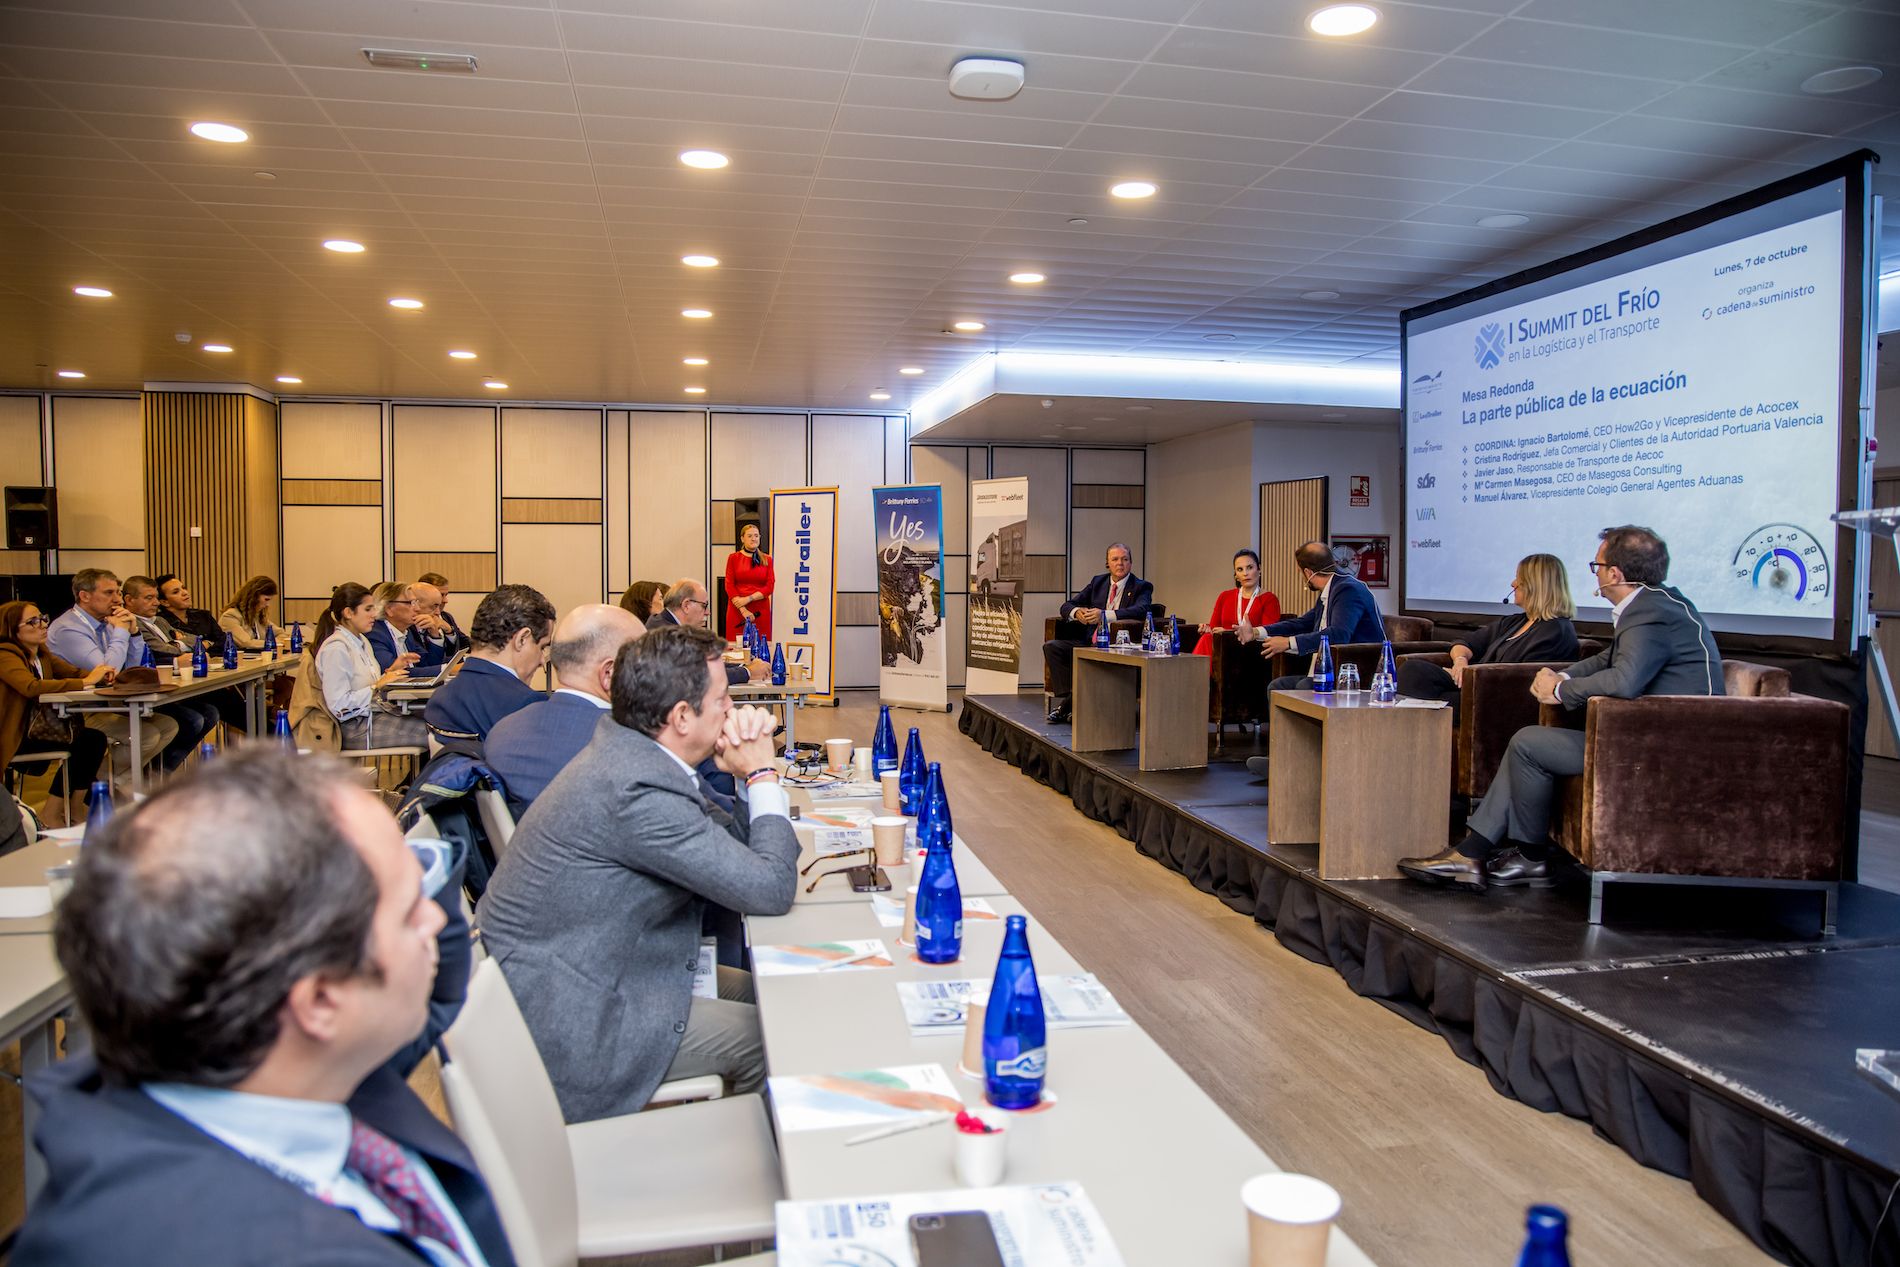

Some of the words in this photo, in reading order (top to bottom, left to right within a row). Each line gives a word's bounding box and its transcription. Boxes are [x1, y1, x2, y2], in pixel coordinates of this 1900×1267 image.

[1714, 262, 1744, 276] Lunes,
[1746, 259, 1752, 268] 7
[1754, 256, 1766, 266] de
[1768, 244, 1808, 262] octubre
[1716, 300, 1751, 316] cadena
[1759, 285, 1815, 306] suministro
[1738, 280, 1774, 296] organiza
[1508, 351, 1520, 362] en
[1522, 346, 1530, 359] la
[1533, 337, 1577, 358] Logística
[1578, 337, 1586, 349] y
[1588, 329, 1596, 344] el
[1600, 316, 1660, 341] Transporte
[1509, 322, 1513, 344] I
[1462, 390, 1487, 403] Mesa
[1490, 379, 1534, 398] Redonda
[1462, 409, 1476, 424] La
[1480, 404, 1512, 425] parte
[1516, 395, 1564, 419] pública
[1569, 390, 1587, 407] de
[1592, 386, 1604, 404] la
[1610, 370, 1687, 400] ecuación
[1474, 440, 1516, 452] COORDINA:
[1518, 434, 1545, 448] Ignacio
[1548, 428, 1591, 442] Bartolomé,
[1594, 425, 1612, 436] CEO
[1616, 420, 1653, 434] How2Go
[1656, 420, 1662, 430] y
[1664, 410, 1736, 428] Vicepresidente
[1740, 406, 1753, 416] de
[1756, 400, 1799, 414] Acocex
[1474, 454, 1501, 465] Cristina
[1502, 450, 1542, 462] Rodríguez,
[1560, 442, 1600, 455] Comercial
[1602, 442, 1608, 453] y
[1610, 435, 1644, 449] Clientes
[1646, 434, 1658, 444] de
[1660, 432, 1669, 443] la
[1671, 426, 1718, 442] Autoridad
[1722, 420, 1771, 435] Portuaria
[1774, 413, 1824, 430] Valencia
[1474, 468, 1495, 478] Javier
[1517, 461, 1564, 474] Responsable
[1565, 459, 1575, 468] de
[1577, 454, 1620, 468] Transporte
[1622, 452, 1633, 463] de
[1635, 450, 1664, 462] Aecoc
[1484, 478, 1512, 488] Carmen
[1514, 475, 1554, 488] Masegosa,
[1556, 473, 1574, 484] CEO
[1576, 470, 1587, 482] de
[1588, 468, 1631, 482] Masegosa
[1633, 463, 1682, 477] Consulting
[1474, 493, 1499, 502] Manuel
[1500, 488, 1529, 501] Álvarez,
[1530, 487, 1585, 500] Vicepresidente
[1586, 484, 1618, 497] Colegio
[1620, 480, 1655, 492] General
[1657, 476, 1696, 492] Agentes
[1699, 474, 1744, 486] Aduanas
[884, 511, 925, 565] Yes
[1786, 533, 1798, 542] 10
[1804, 546, 1817, 556] 20
[1746, 548, 1756, 556] 10
[793, 502, 812, 636] LeciTrailer
[1812, 564, 1825, 574] 30
[1812, 584, 1826, 592] 40
